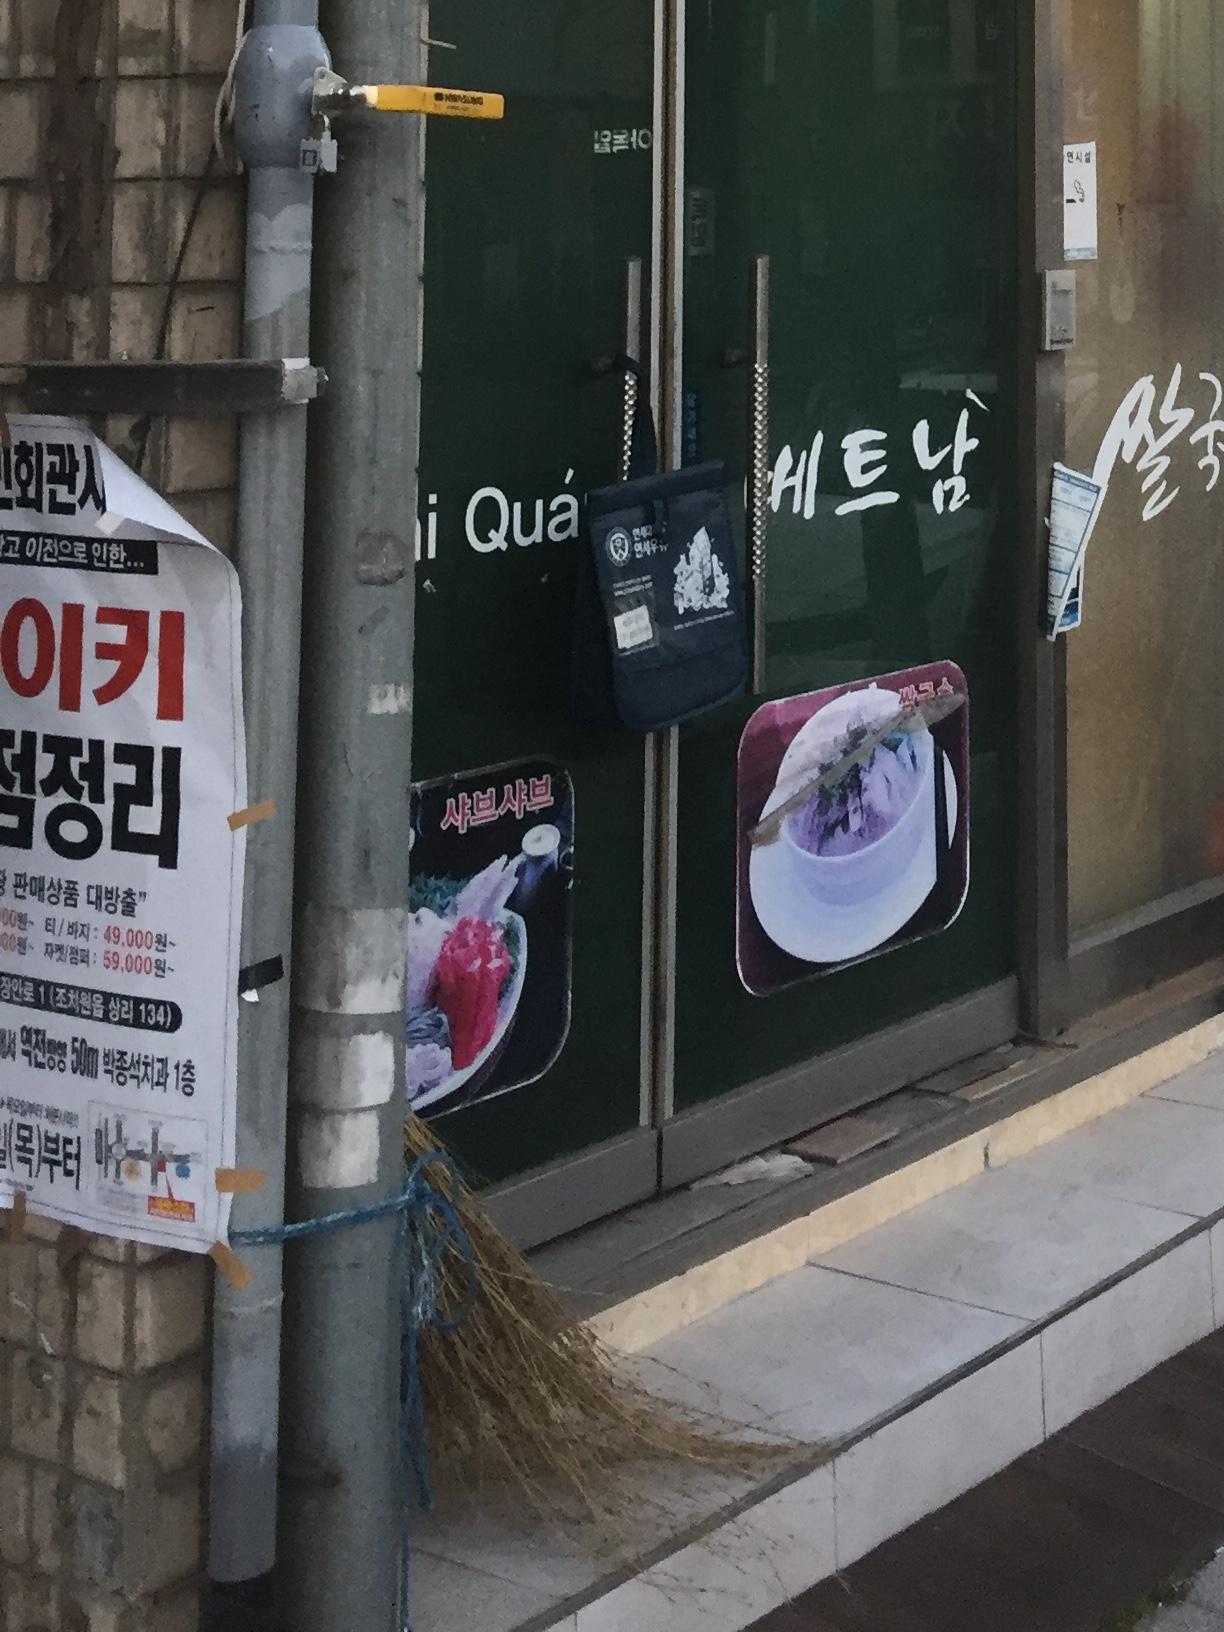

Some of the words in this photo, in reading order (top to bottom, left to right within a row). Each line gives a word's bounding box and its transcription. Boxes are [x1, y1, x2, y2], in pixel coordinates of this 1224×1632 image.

[465, 468, 587, 564] Quá
[26, 536, 88, 564] 이전으로
[1, 597, 185, 721] 이키
[440, 774, 554, 835] 샤브샤브
[13, 871, 80, 909] 판매상품
